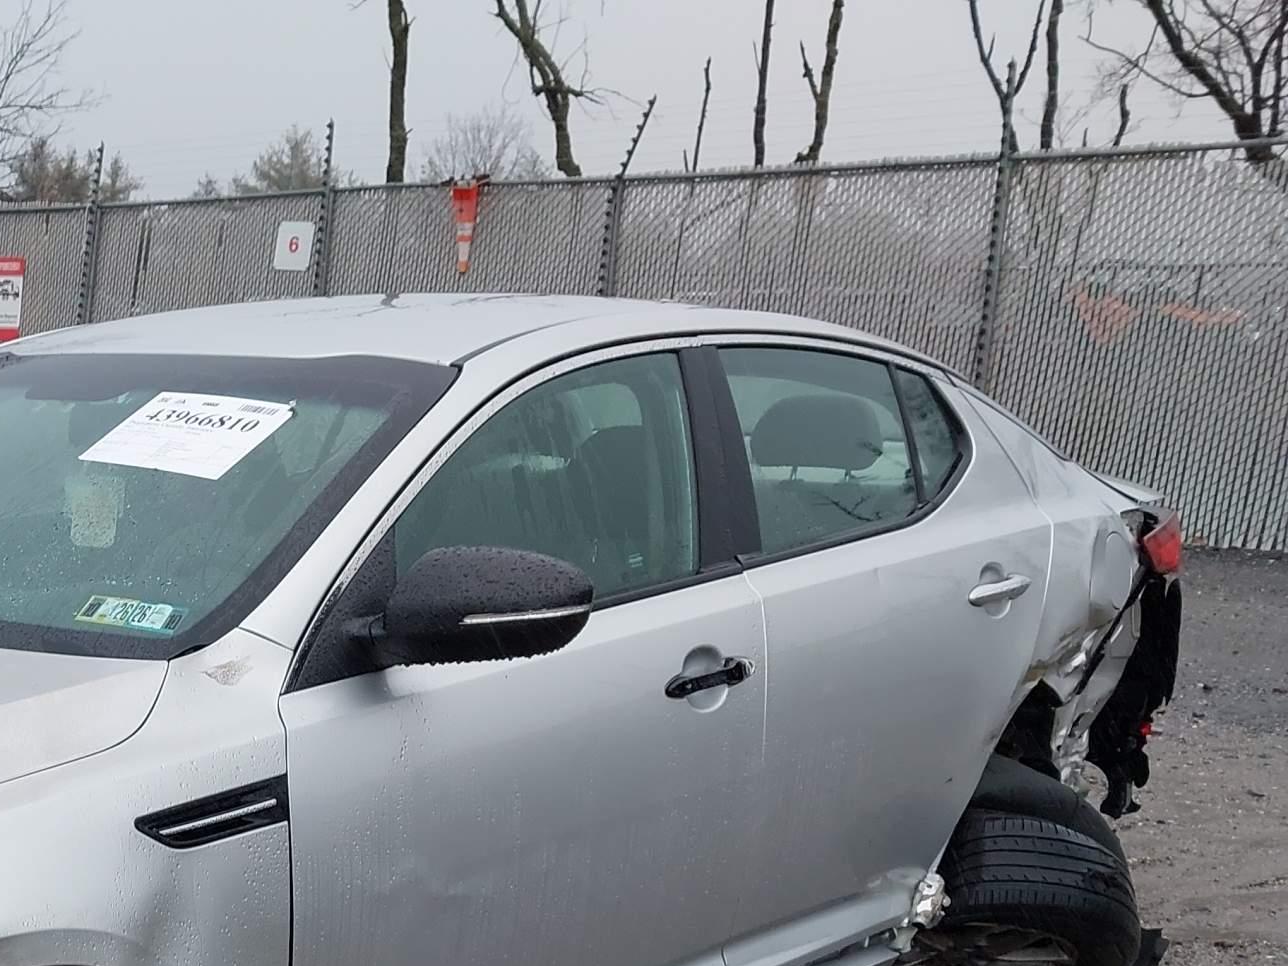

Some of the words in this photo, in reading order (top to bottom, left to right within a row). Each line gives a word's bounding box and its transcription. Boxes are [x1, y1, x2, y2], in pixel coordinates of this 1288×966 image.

[289, 235, 299, 254] 6
[145, 407, 260, 433] 43966810
[131, 604, 152, 624] 26
